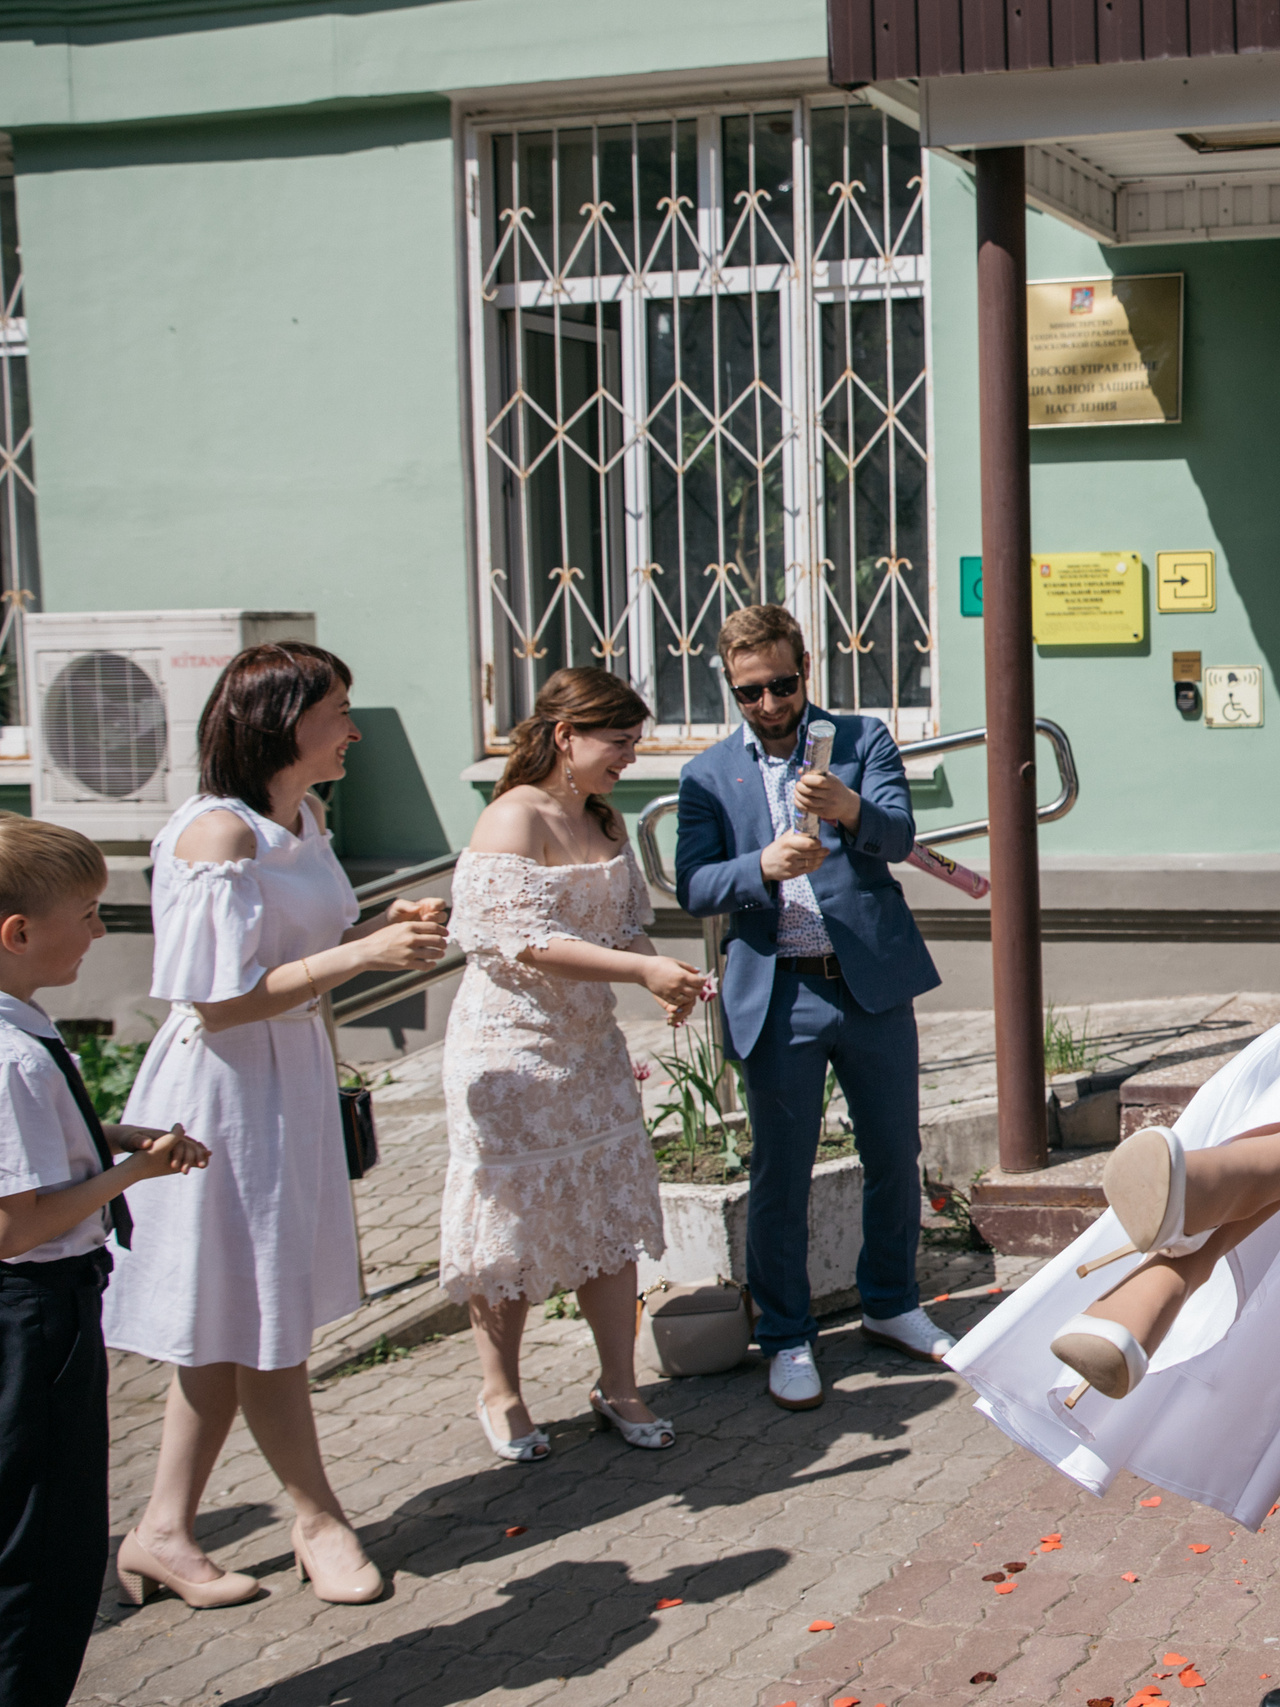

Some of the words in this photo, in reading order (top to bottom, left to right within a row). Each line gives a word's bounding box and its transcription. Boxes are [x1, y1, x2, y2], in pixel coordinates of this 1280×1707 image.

[1029, 364, 1078, 377] ОВСКОЕ
[1080, 361, 1158, 374] УПРАВЛЕНИЕ
[1029, 383, 1095, 397] ЦИАЛЬНОЙ
[1045, 401, 1118, 415] НАСЕЛЕНИЯ
